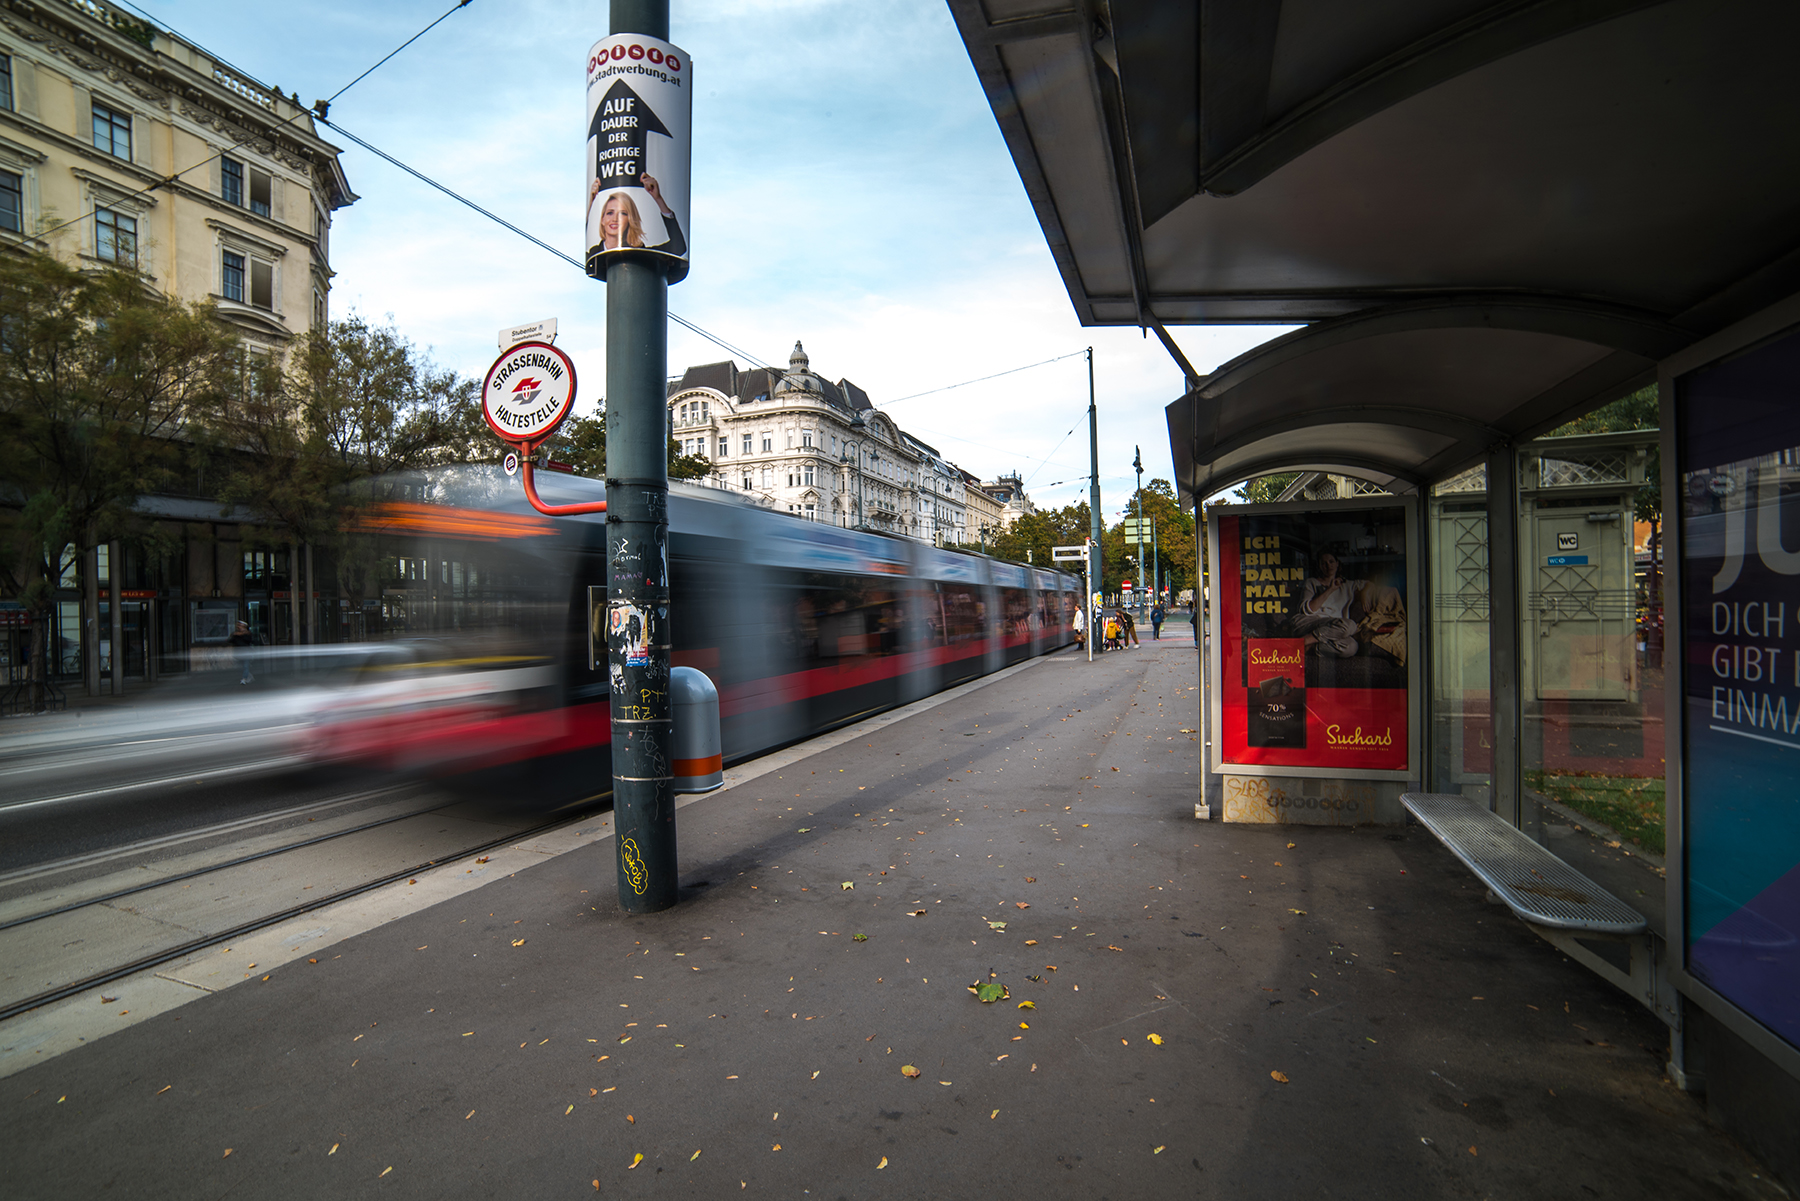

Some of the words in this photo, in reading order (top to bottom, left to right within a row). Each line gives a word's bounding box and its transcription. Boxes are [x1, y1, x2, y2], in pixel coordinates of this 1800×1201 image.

[603, 97, 635, 116] AUF
[601, 115, 638, 132] DAUER
[608, 132, 628, 143] DER
[599, 146, 640, 162] RICHTIGE
[601, 160, 636, 179] WEG
[511, 326, 537, 337] Stubentor
[492, 353, 564, 391] STRASSENBAHN
[495, 396, 560, 428] HALTESTELLE
[1244, 536, 1280, 550] ICH
[1560, 536, 1576, 545] WC
[1245, 552, 1281, 565] BIN
[1245, 567, 1304, 582] DANN
[1246, 584, 1291, 598] MAL
[1246, 600, 1289, 614] ICH.
[1712, 601, 1785, 638] DICH
[1251, 648, 1302, 665] Suchard
[1712, 644, 1781, 684] GIBT
[1267, 703, 1287, 713] 70%
[1259, 711, 1294, 721] SENSATIONS
[1326, 723, 1393, 746] Suchard
